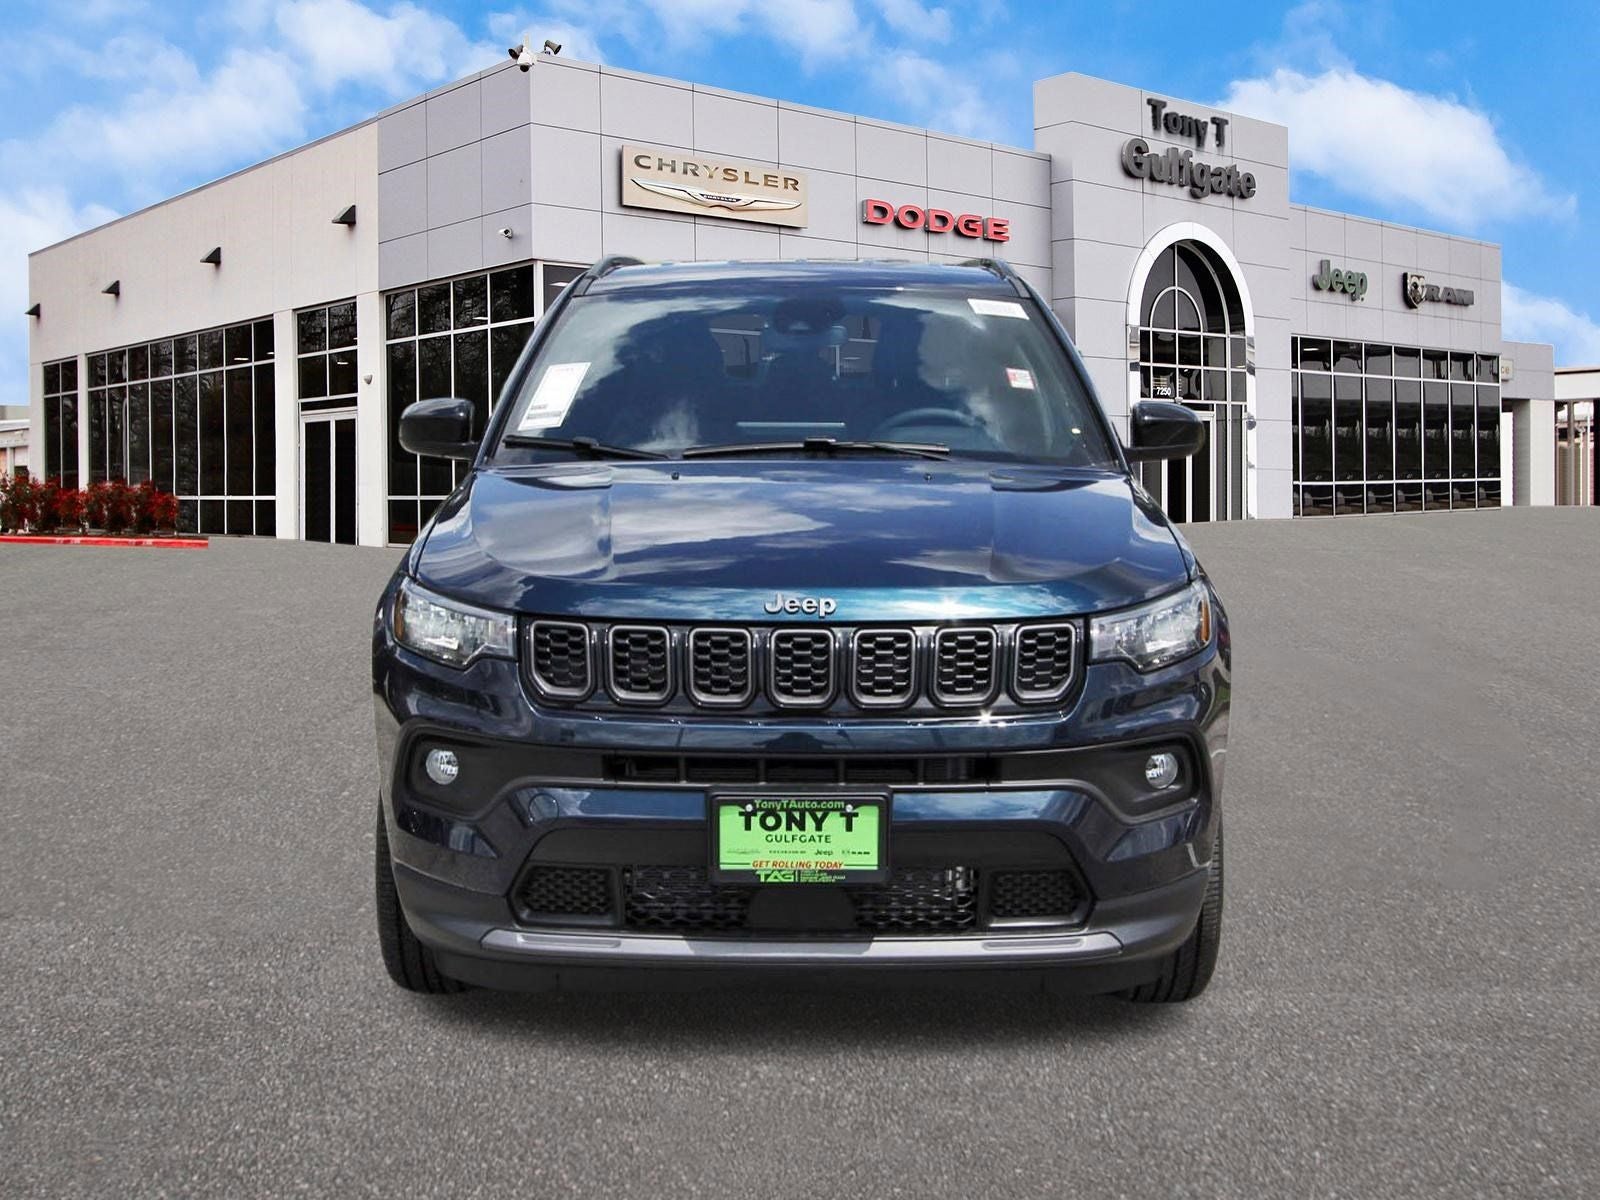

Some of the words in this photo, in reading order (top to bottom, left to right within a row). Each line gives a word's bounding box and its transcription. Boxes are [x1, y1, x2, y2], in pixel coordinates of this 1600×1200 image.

[1146, 97, 1208, 148] Tony
[1210, 116, 1229, 147] T
[633, 154, 800, 192] CHRYSLER
[1121, 137, 1257, 199] Gulfgate
[862, 198, 1010, 243] DODGE
[1312, 259, 1367, 302] Jeep
[1424, 283, 1475, 306] RAM
[1156, 386, 1172, 396] 7250
[764, 592, 836, 618] Jeep
[754, 799, 845, 810] TonyTAuto.com
[738, 809, 831, 832] TONY
[839, 811, 859, 832] T
[765, 833, 832, 844] GULFGATE
[752, 860, 769, 868] GET
[772, 860, 811, 869] ROLLING
[815, 860, 844, 869] TODAY
[755, 870, 794, 882] TAG
